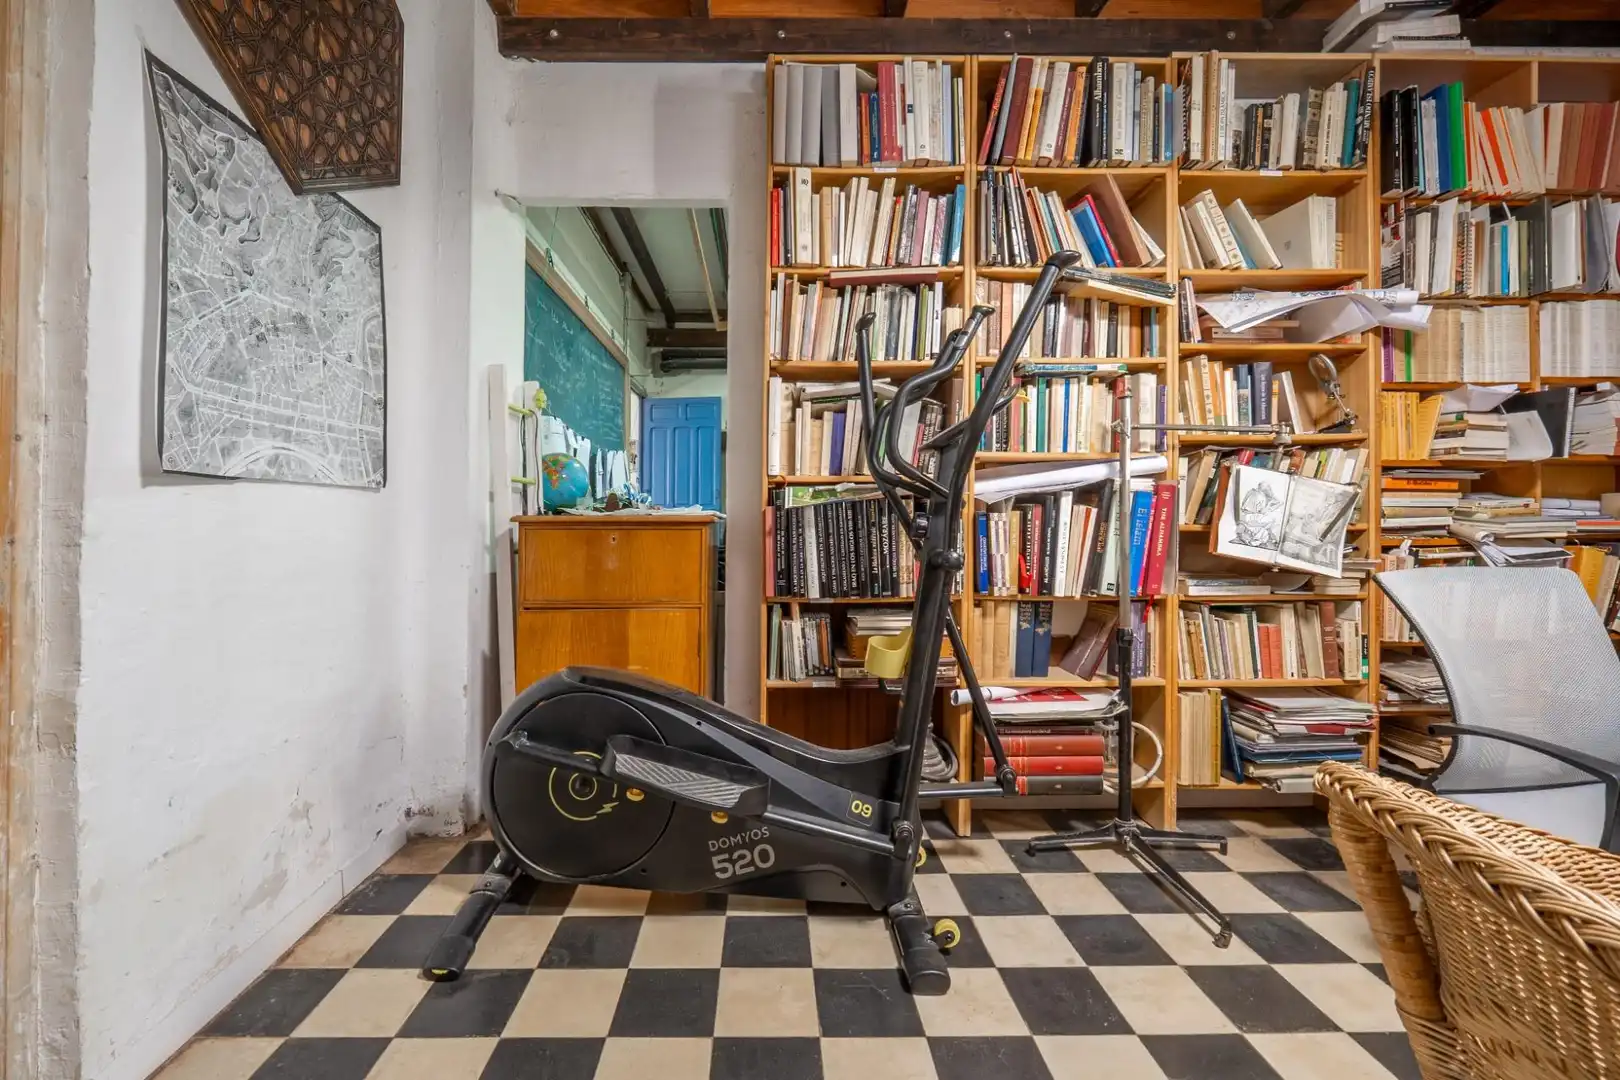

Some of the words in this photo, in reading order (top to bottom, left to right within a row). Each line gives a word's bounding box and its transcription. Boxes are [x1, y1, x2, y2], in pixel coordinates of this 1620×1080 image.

[1093, 61, 1102, 101] Alhambra
[1136, 507, 1146, 517] El
[1133, 519, 1145, 545] islam
[1155, 521, 1165, 556] ALHAMBRA
[851, 799, 873, 818] 09
[707, 826, 770, 852] DOMYOS
[711, 843, 775, 880] 520
